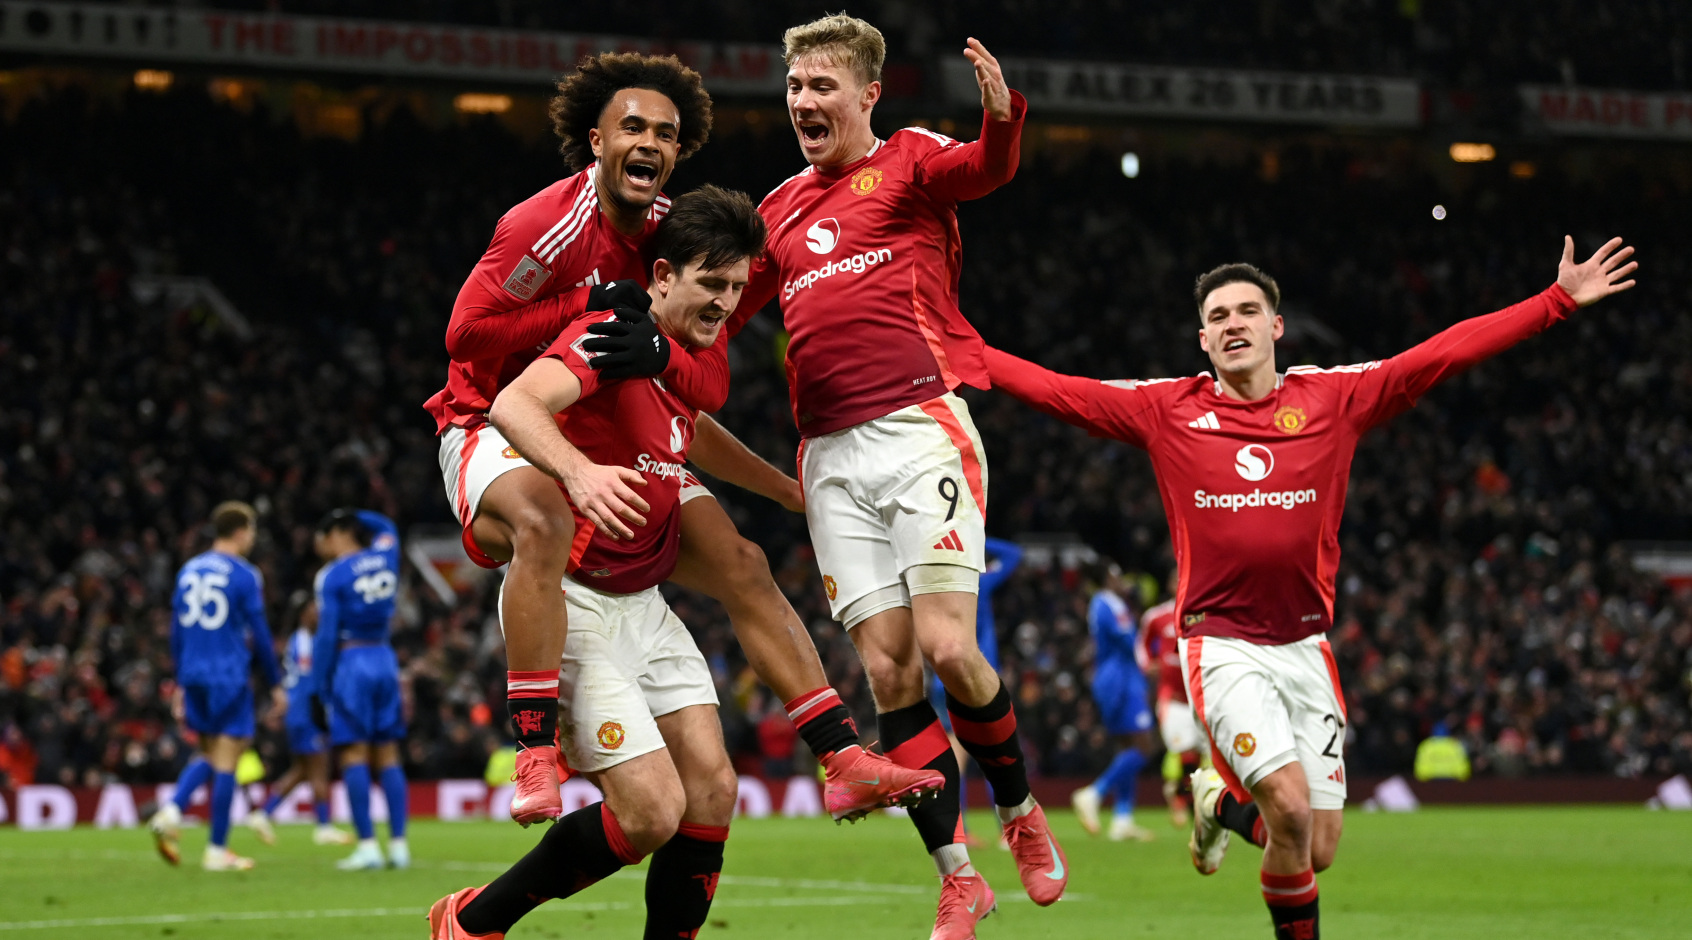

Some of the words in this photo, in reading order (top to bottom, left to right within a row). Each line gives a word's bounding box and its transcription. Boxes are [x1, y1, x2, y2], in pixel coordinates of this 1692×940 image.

[205, 13, 294, 55] THE
[1066, 71, 1170, 102] ALEX
[1251, 82, 1383, 114] YEARS
[1540, 93, 1648, 127] MADE
[784, 248, 892, 301] Snapdragon
[937, 476, 959, 523] 9
[1194, 488, 1317, 512] Snapdragon
[178, 571, 230, 630] 35
[1321, 713, 1345, 759] 2
